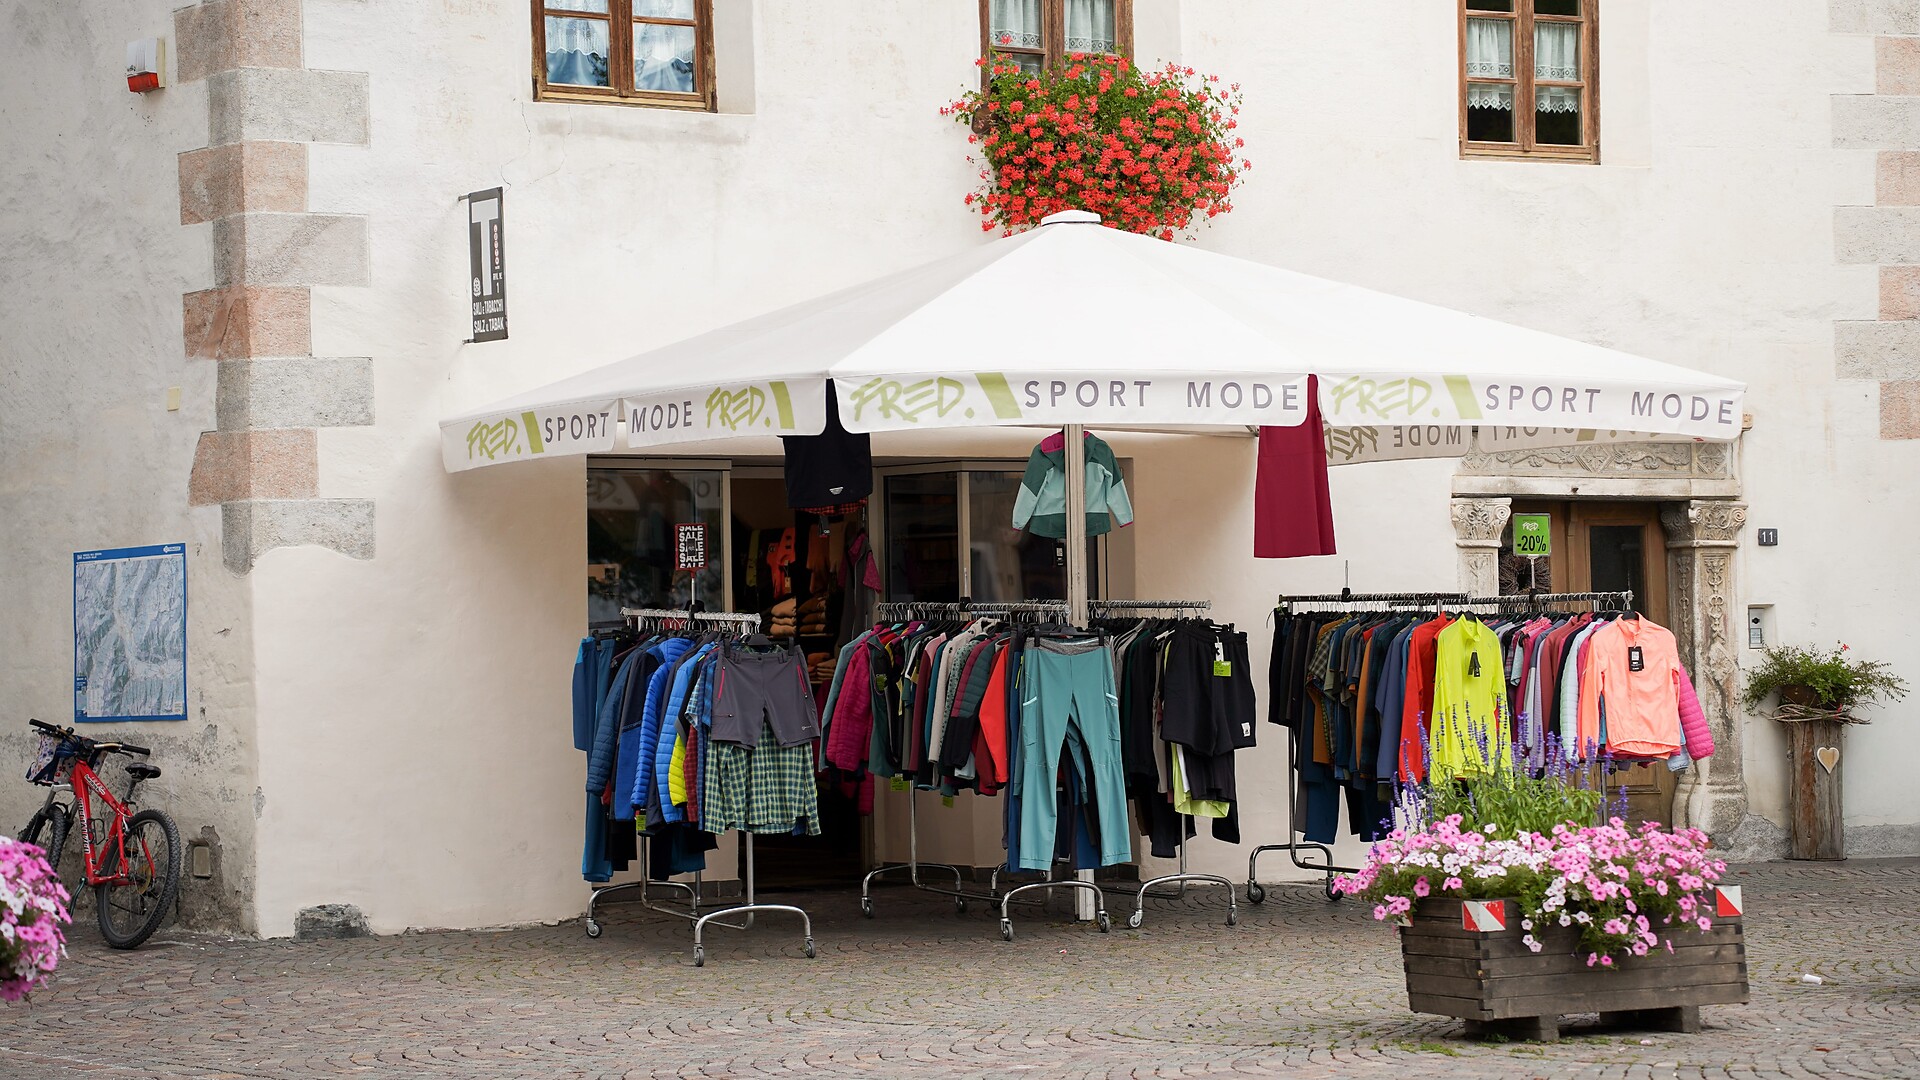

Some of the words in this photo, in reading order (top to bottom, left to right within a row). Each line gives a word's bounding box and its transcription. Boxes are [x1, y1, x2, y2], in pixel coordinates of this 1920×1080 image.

[472, 197, 498, 296] T
[474, 319, 486, 333] SALZ
[488, 317, 505, 331] TABAK
[1024, 380, 1151, 408] SPORT
[1187, 381, 1298, 411] MODE
[1485, 384, 1600, 414] SPORT
[1631, 391, 1734, 425] MODE
[545, 412, 609, 443] SPORT
[631, 400, 693, 433] MODE
[679, 532, 703, 541] SALE
[1517, 535, 1547, 551] -20%
[1762, 531, 1774, 543] 11
[679, 542, 704, 552] SE
